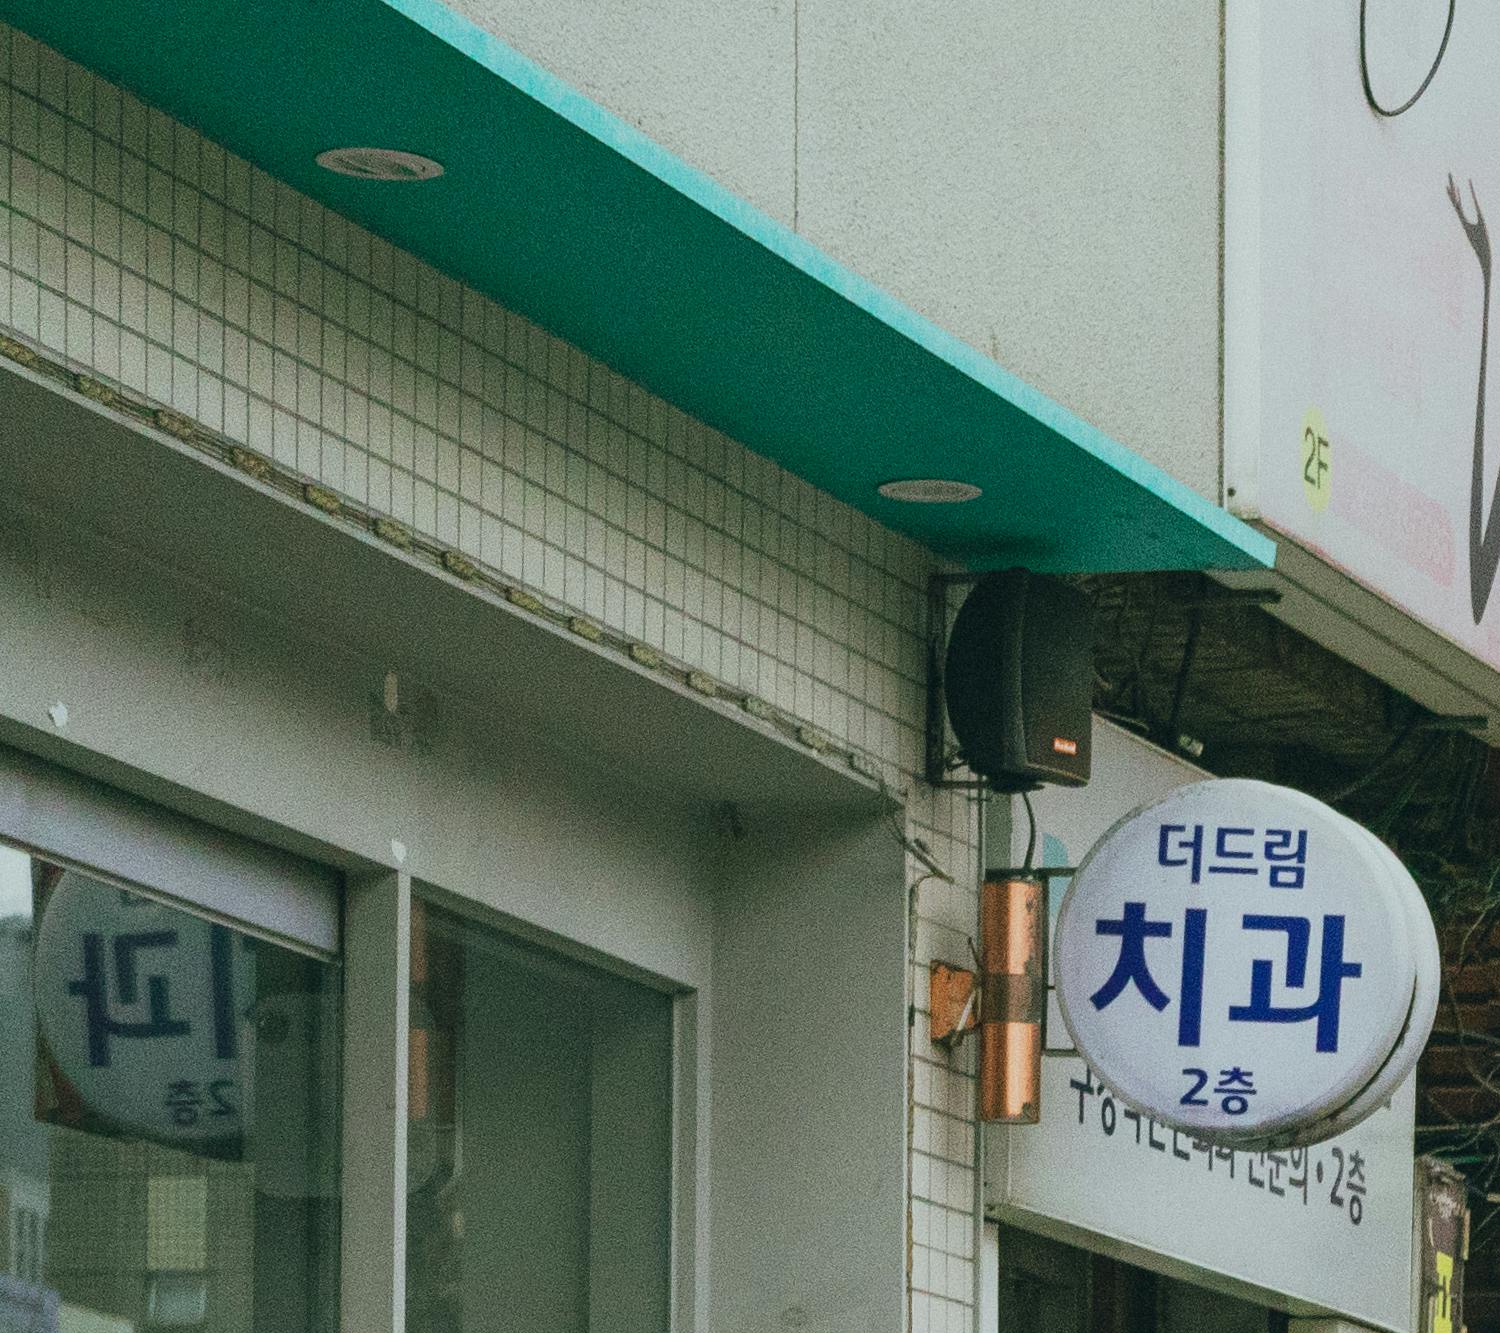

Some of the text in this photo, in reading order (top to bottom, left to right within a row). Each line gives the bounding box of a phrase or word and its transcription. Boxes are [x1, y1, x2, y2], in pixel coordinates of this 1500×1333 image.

[1303, 427, 1329, 489] 2F
[1158, 824, 1308, 889] 더드림
[1089, 902, 1362, 1053] 치과
[1180, 1067, 1257, 1115] 2층
